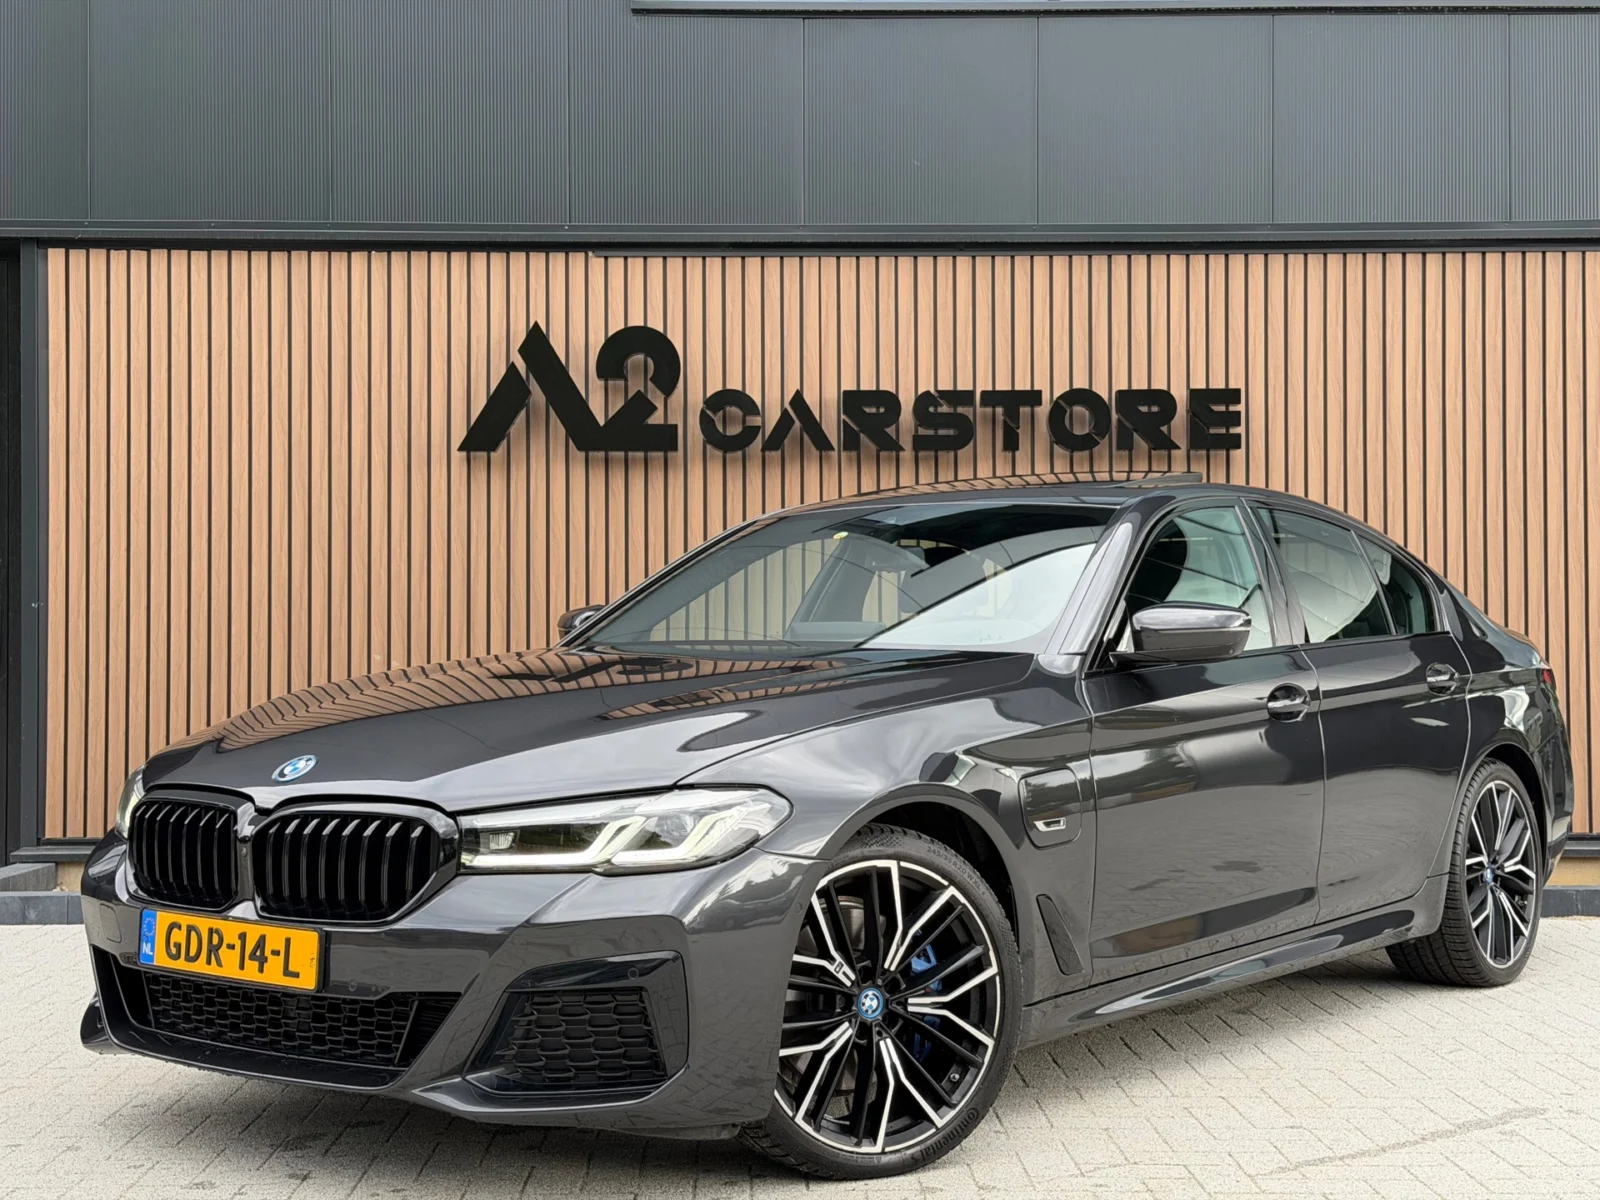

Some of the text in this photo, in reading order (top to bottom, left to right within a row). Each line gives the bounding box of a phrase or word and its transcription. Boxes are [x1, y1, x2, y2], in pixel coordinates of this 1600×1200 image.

[457, 320, 1242, 453] A2 CARSTORE
[142, 942, 153, 956] NL
[164, 920, 300, 979] GDR-14-L
[920, 1107, 980, 1160] Continental
